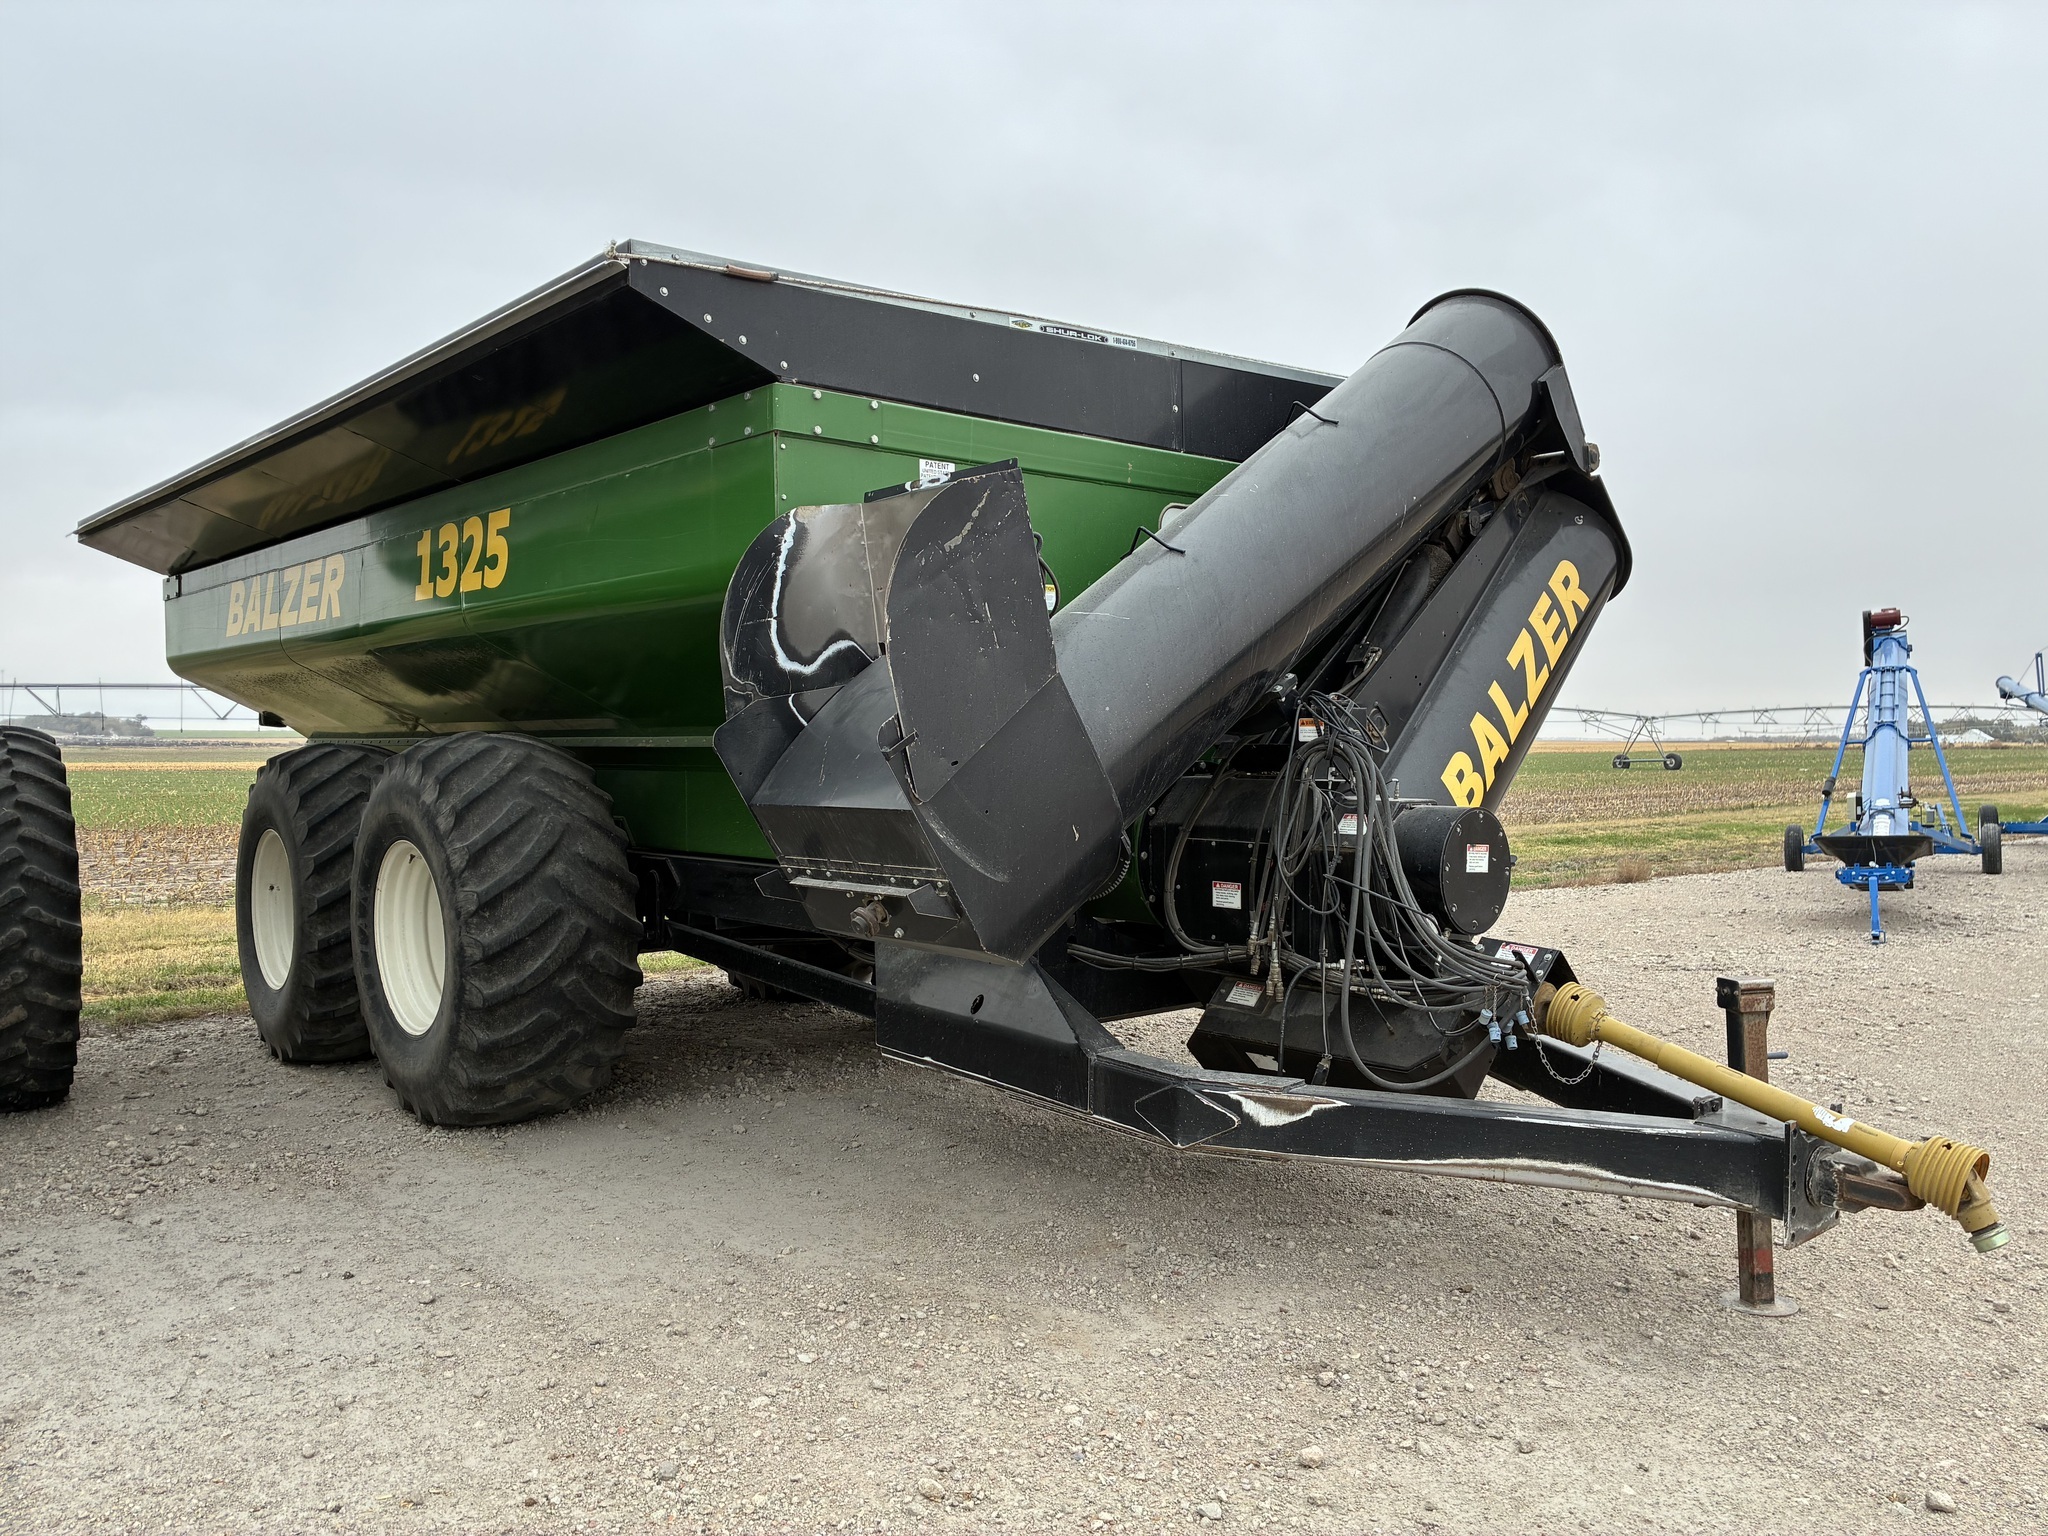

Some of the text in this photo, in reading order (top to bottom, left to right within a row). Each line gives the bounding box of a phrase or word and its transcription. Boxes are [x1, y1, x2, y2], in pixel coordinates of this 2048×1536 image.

[1045, 326, 1102, 342] SHUR-LOK
[925, 461, 949, 470] PATENT
[226, 552, 346, 638] BALZER
[414, 507, 511, 601] 1325
[1440, 559, 1590, 808] BALZER
